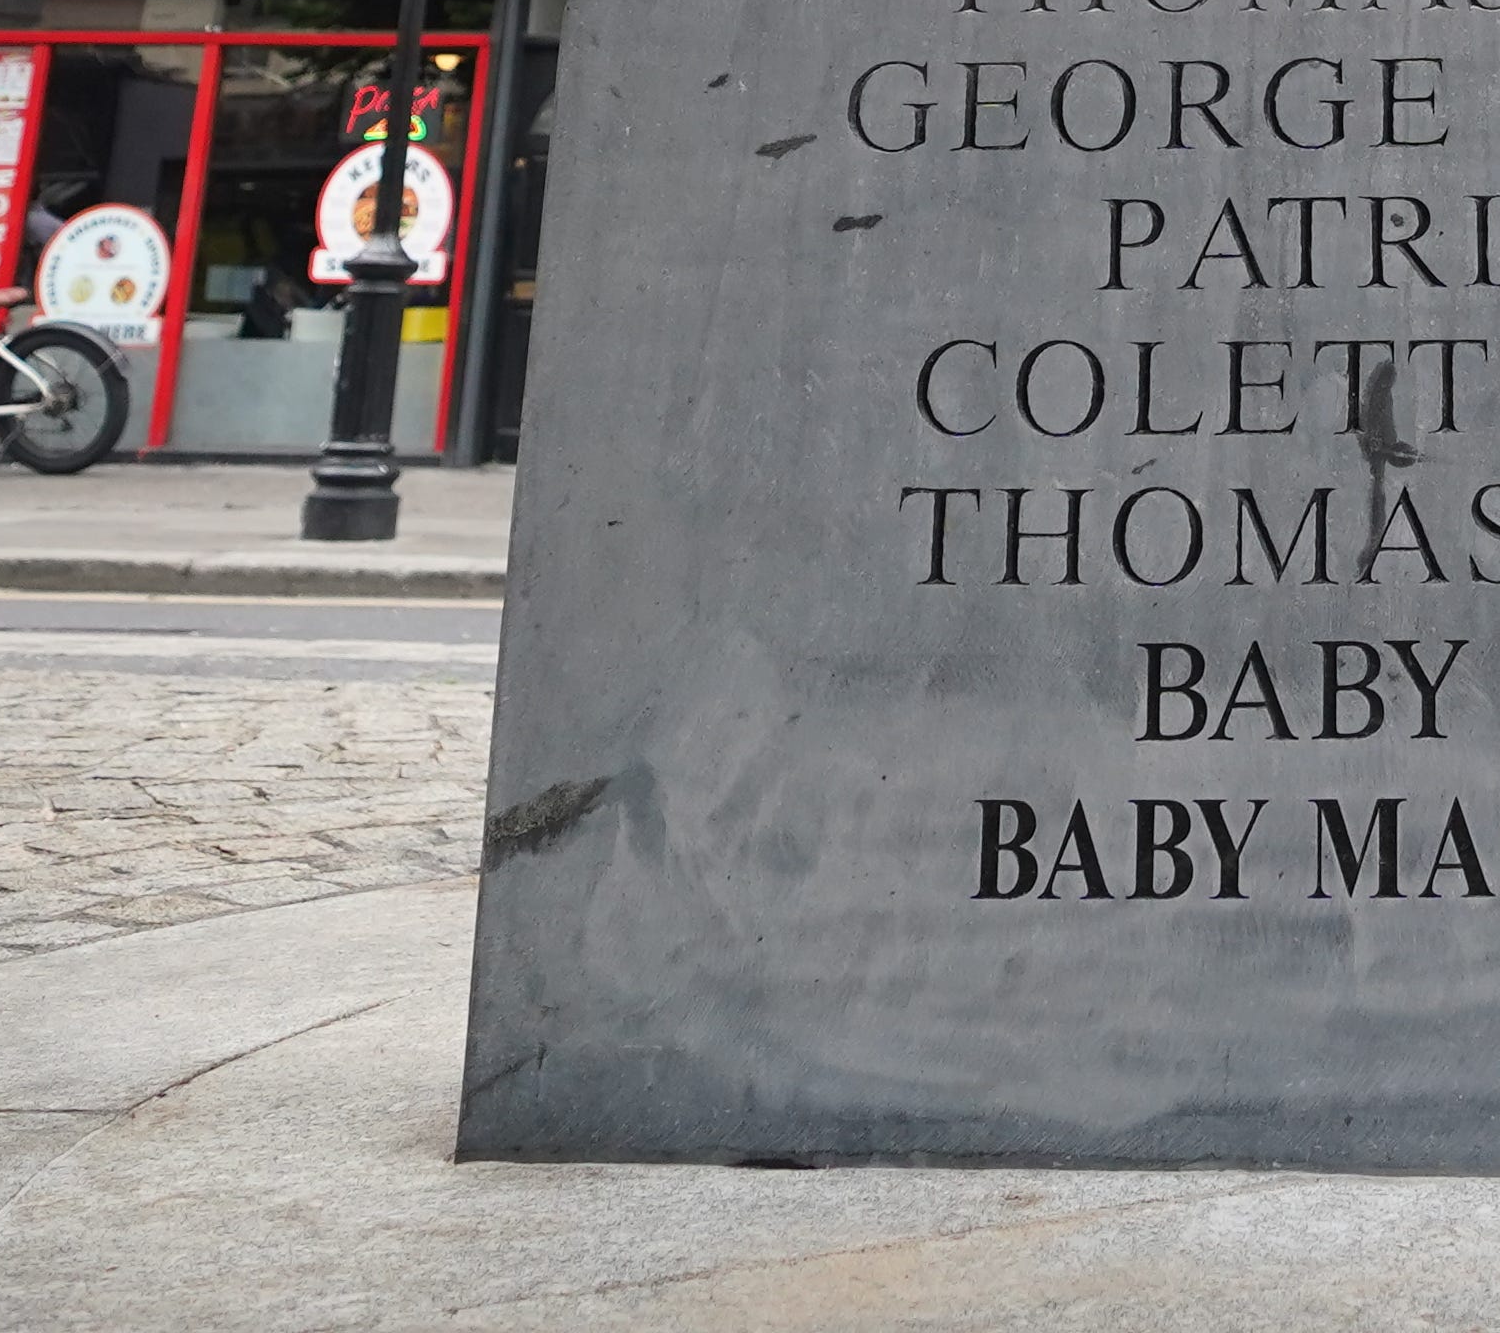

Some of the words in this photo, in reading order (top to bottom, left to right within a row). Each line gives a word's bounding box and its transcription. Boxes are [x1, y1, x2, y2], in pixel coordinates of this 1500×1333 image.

[847, 55, 1450, 152] GEORGE
[1135, 639, 1470, 743] BABY
[971, 797, 1267, 901] BABY
